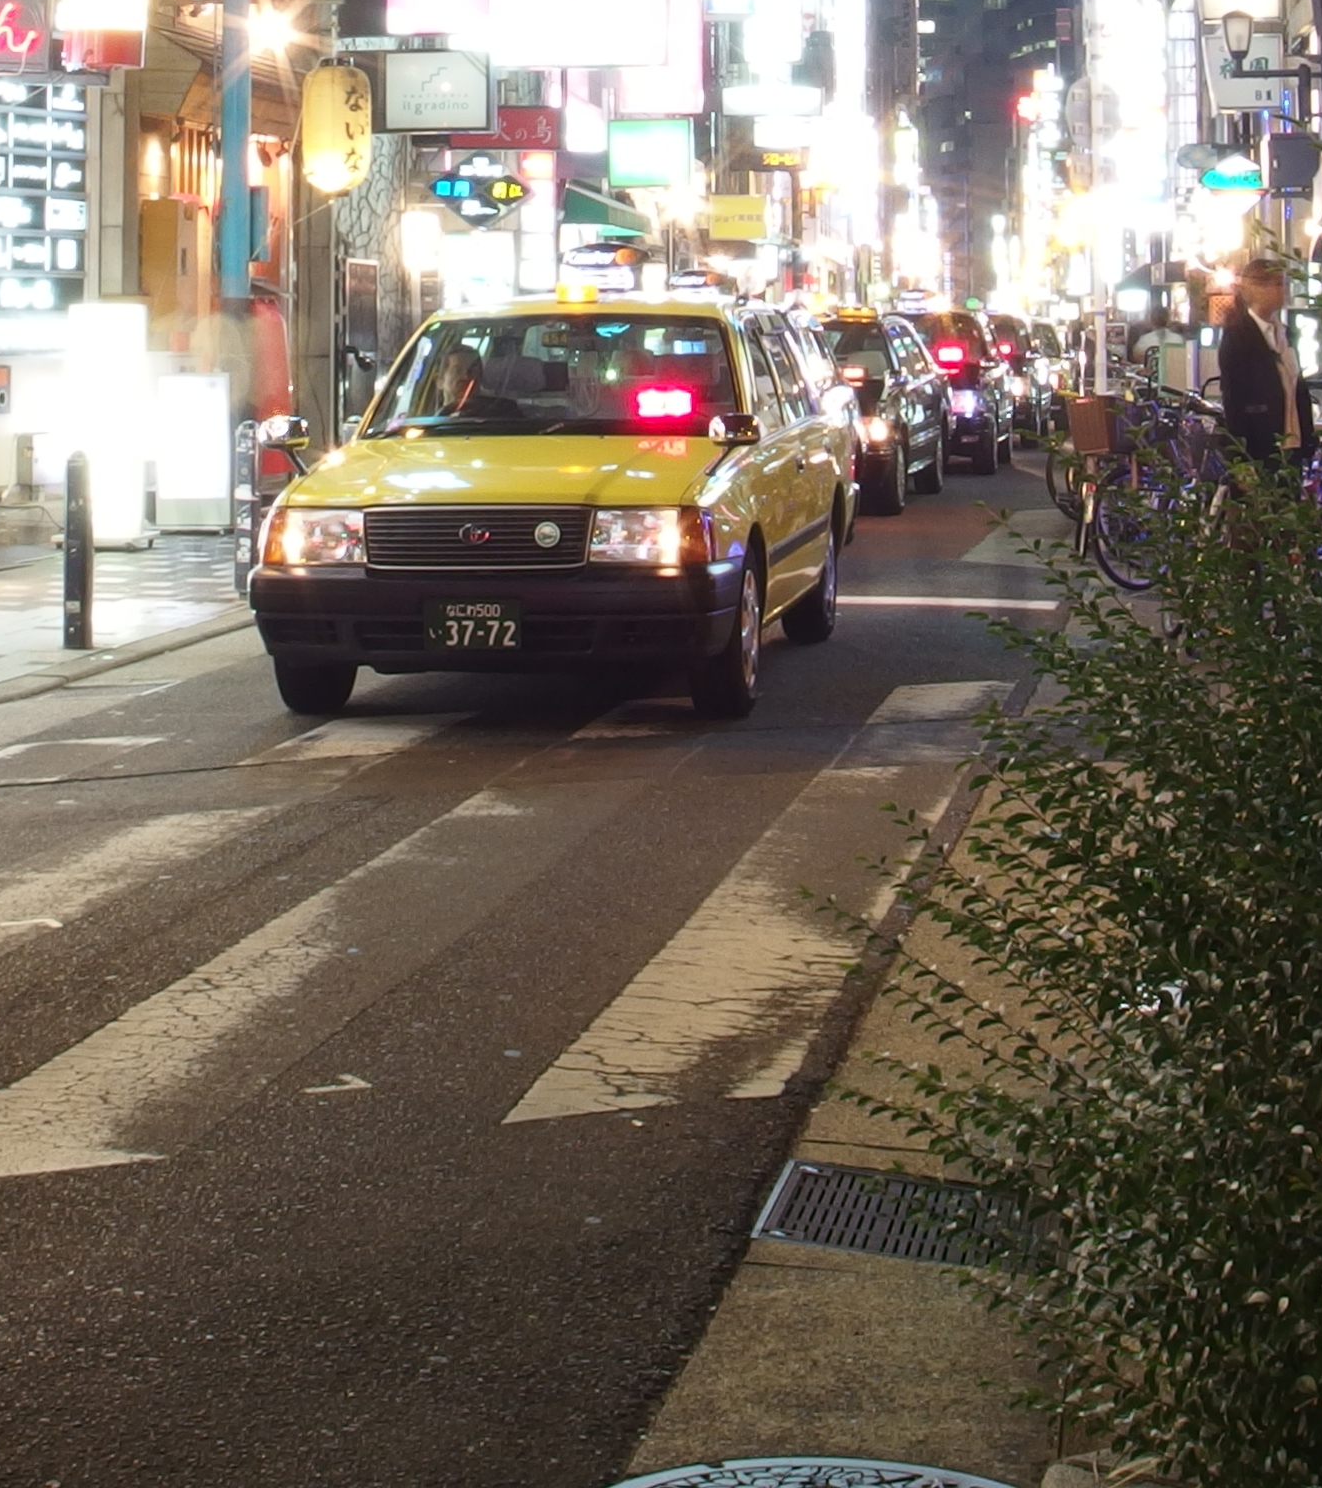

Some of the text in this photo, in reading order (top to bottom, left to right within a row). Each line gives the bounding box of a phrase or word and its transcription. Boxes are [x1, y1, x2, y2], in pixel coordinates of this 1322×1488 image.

[414, 100, 470, 116] gradino
[428, 620, 516, 646] い 37-72
